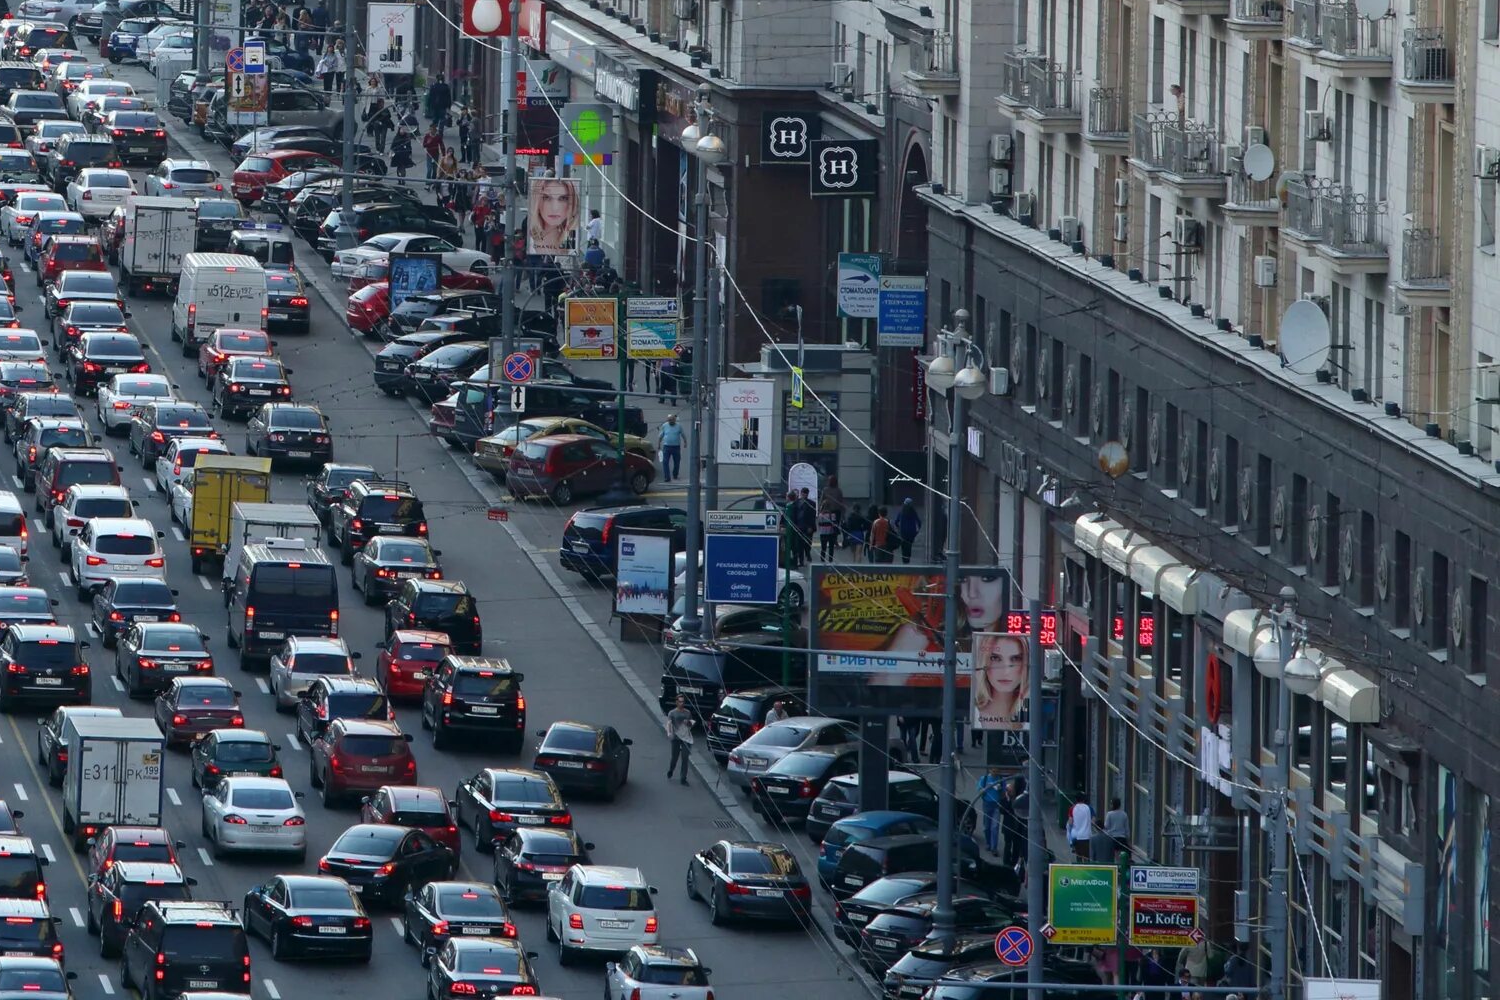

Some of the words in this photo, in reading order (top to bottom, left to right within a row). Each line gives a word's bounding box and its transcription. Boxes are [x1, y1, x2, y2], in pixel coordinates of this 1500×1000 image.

[732, 395, 760, 404] COCO
[837, 585, 893, 601] СЕЗОНА
[144, 766, 159, 775] 199
[1136, 911, 1153, 924] Dr.
[1155, 912, 1192, 926] Koffer
